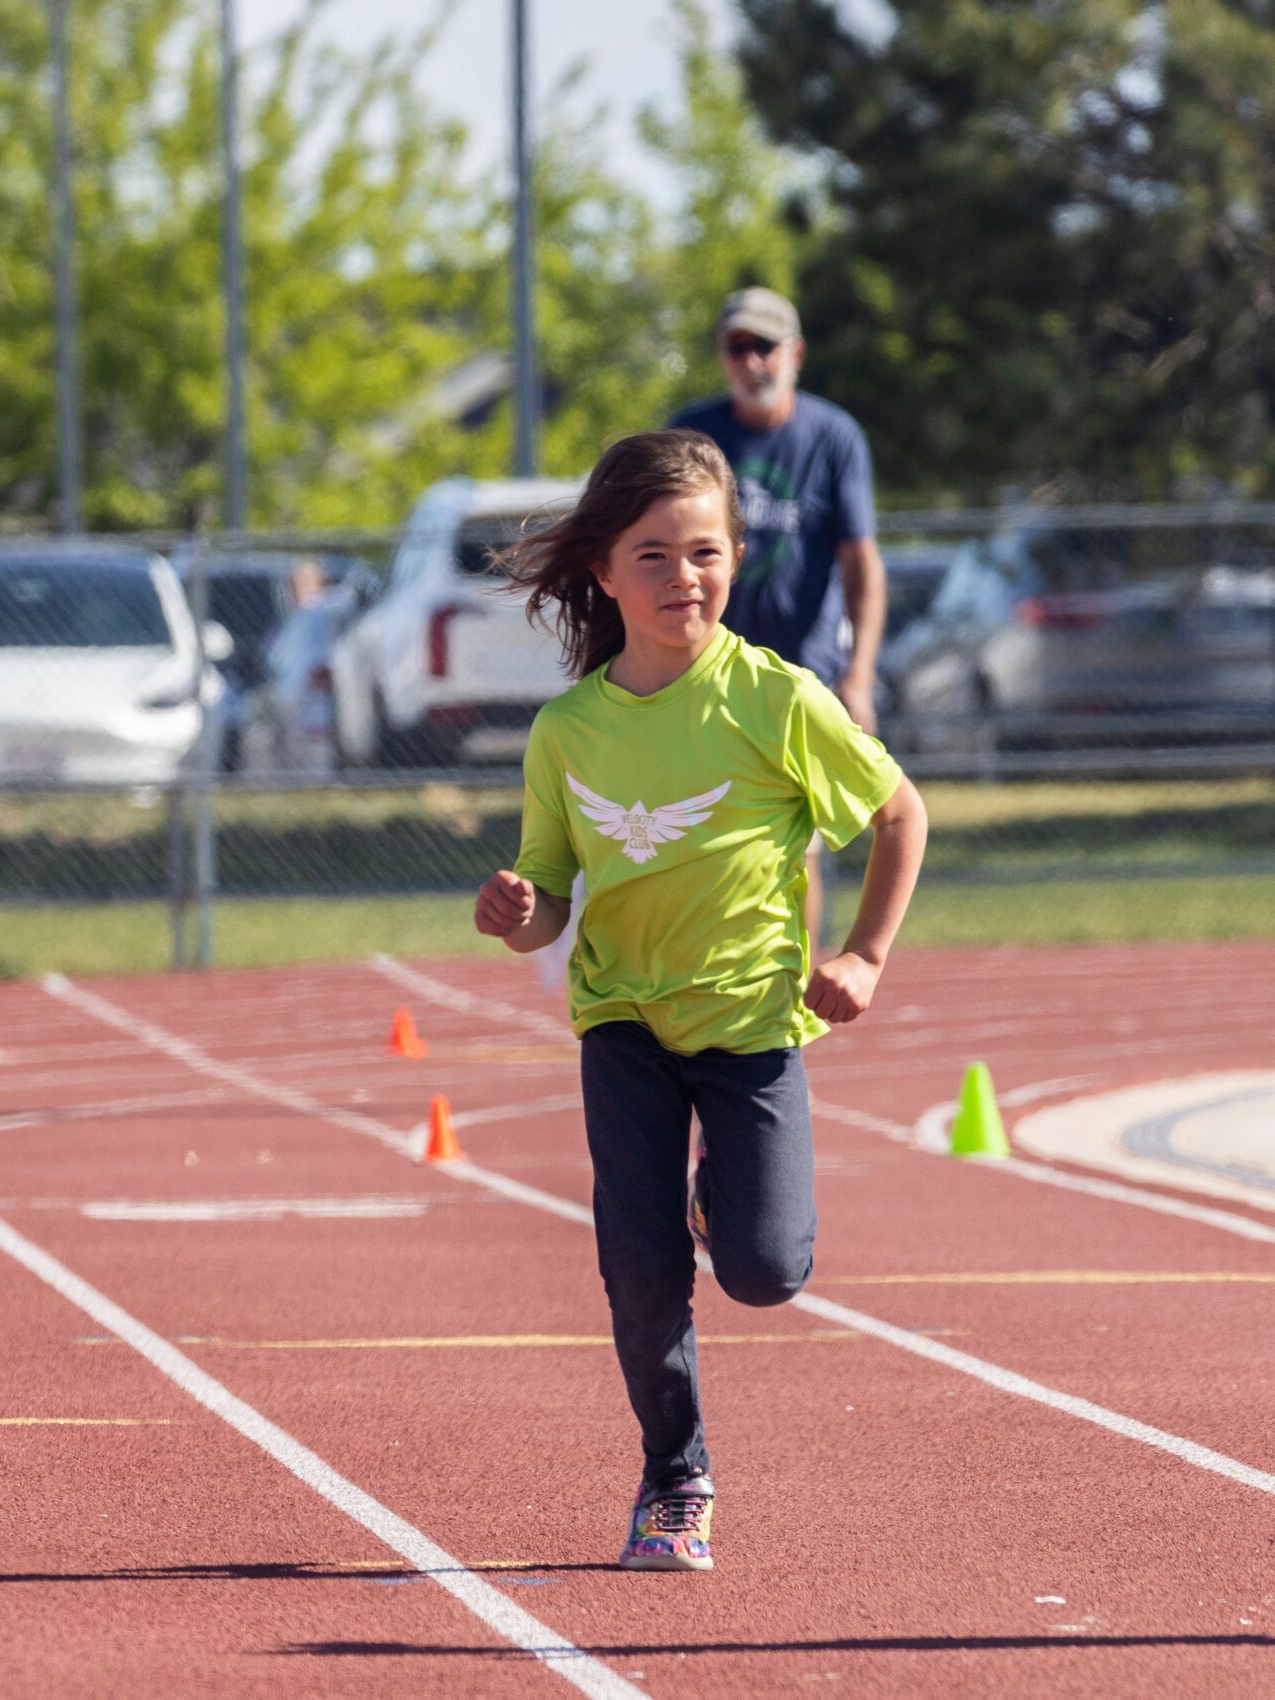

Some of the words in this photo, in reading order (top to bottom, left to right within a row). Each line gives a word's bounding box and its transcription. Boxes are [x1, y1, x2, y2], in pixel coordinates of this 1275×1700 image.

[621, 814, 658, 825] VELOCITY
[630, 825, 648, 837] KIDS
[629, 837, 650, 849] CLUB
